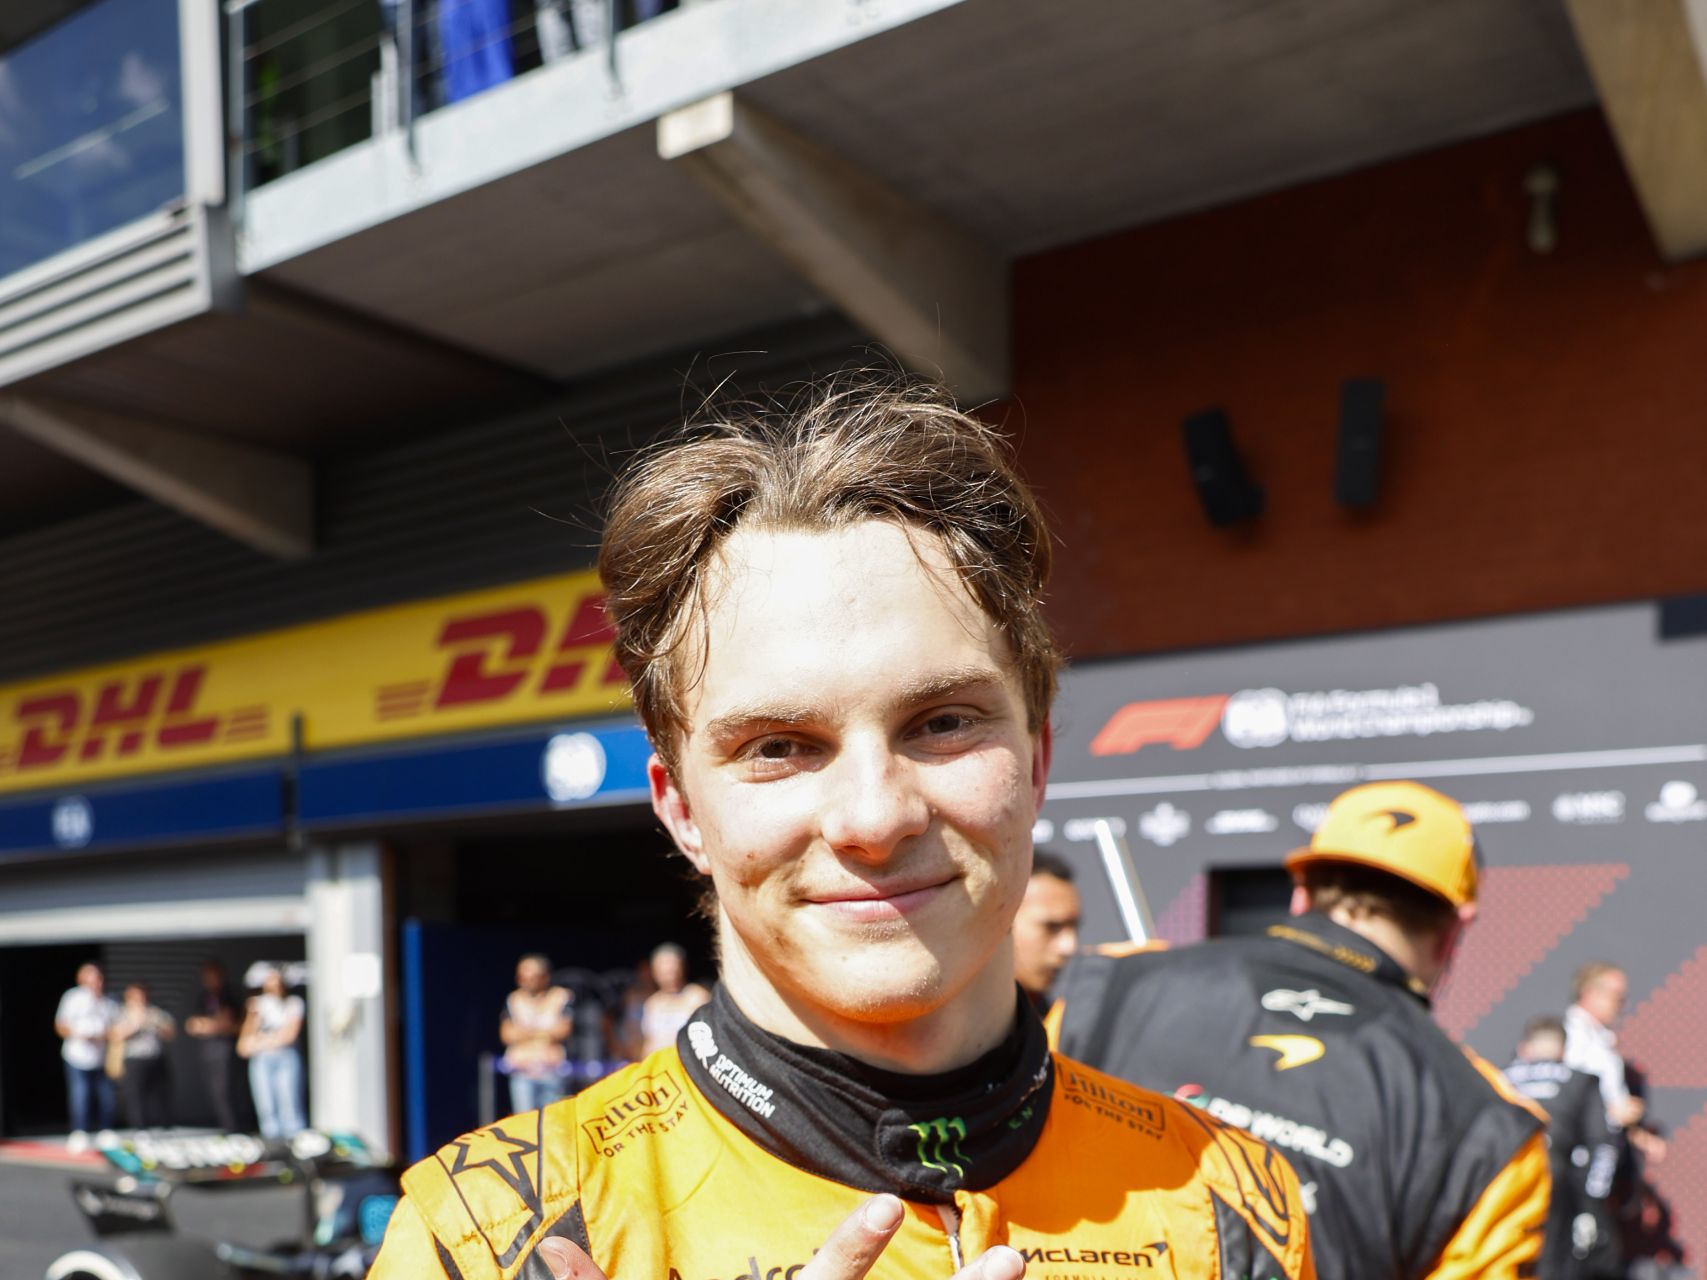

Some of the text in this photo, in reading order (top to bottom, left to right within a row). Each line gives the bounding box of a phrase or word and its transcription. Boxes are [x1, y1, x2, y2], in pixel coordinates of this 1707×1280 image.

[435, 590, 635, 711] DH
[15, 662, 219, 771] DHL
[709, 1064, 776, 1118] NUTRITION
[715, 1054, 774, 1101] OPTIMUM
[600, 1101, 689, 1158] OR THE STAY
[1251, 1110, 1354, 1168] WORLD
[1021, 1247, 1154, 1268] McLaren
